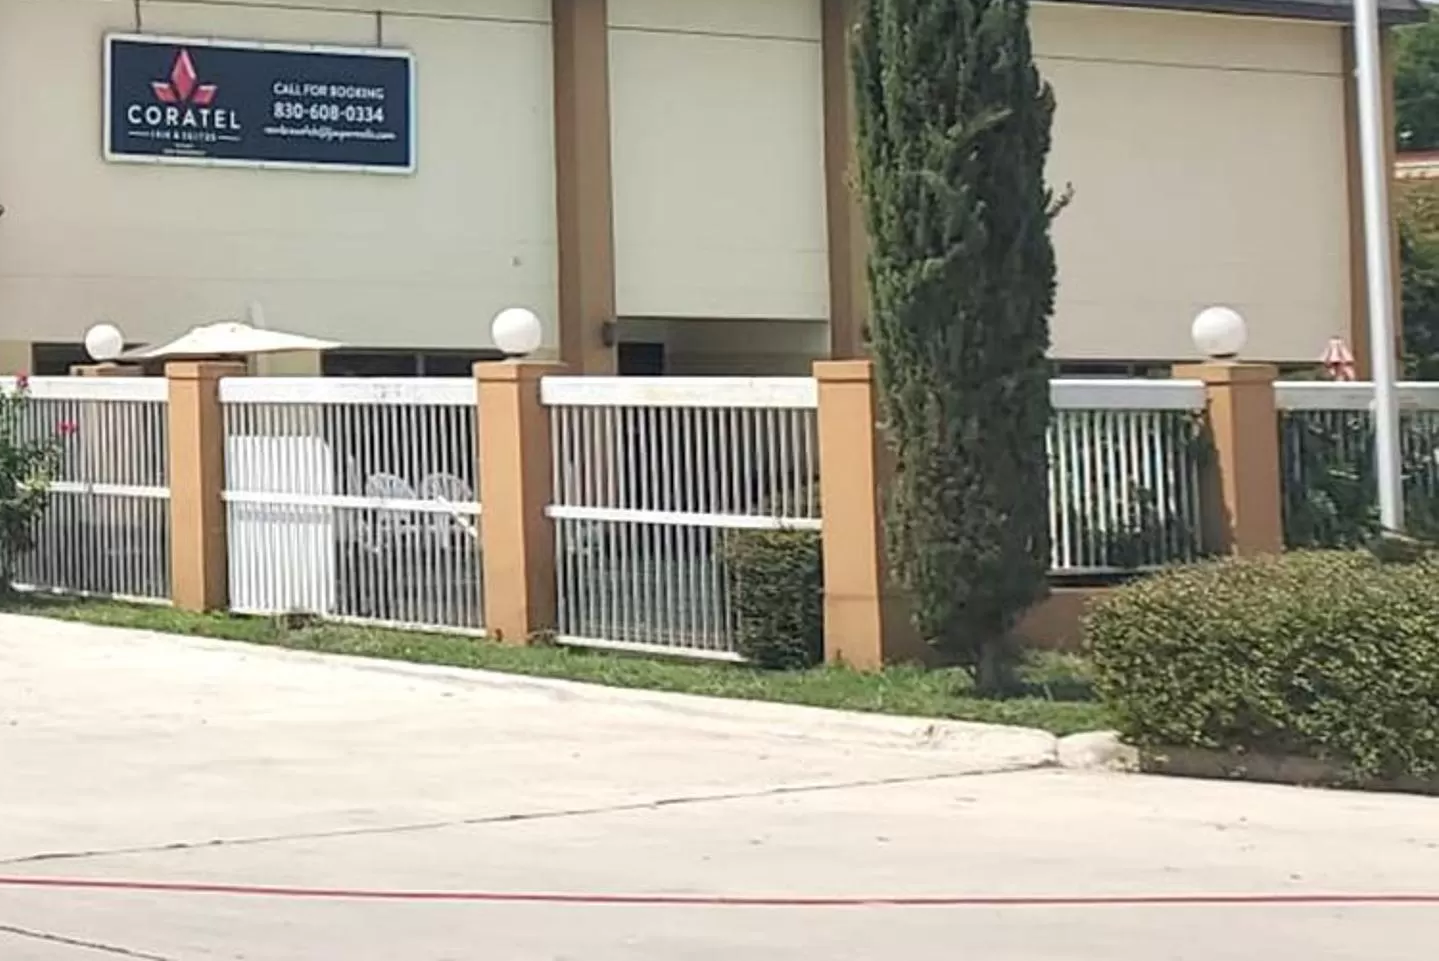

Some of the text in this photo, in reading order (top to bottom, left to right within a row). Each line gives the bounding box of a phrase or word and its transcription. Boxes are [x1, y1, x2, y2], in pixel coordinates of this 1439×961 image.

[273, 82, 385, 100] CALL FOR BOOKING
[127, 104, 241, 130] CORATEL
[273, 102, 385, 123] 830-608-0334
